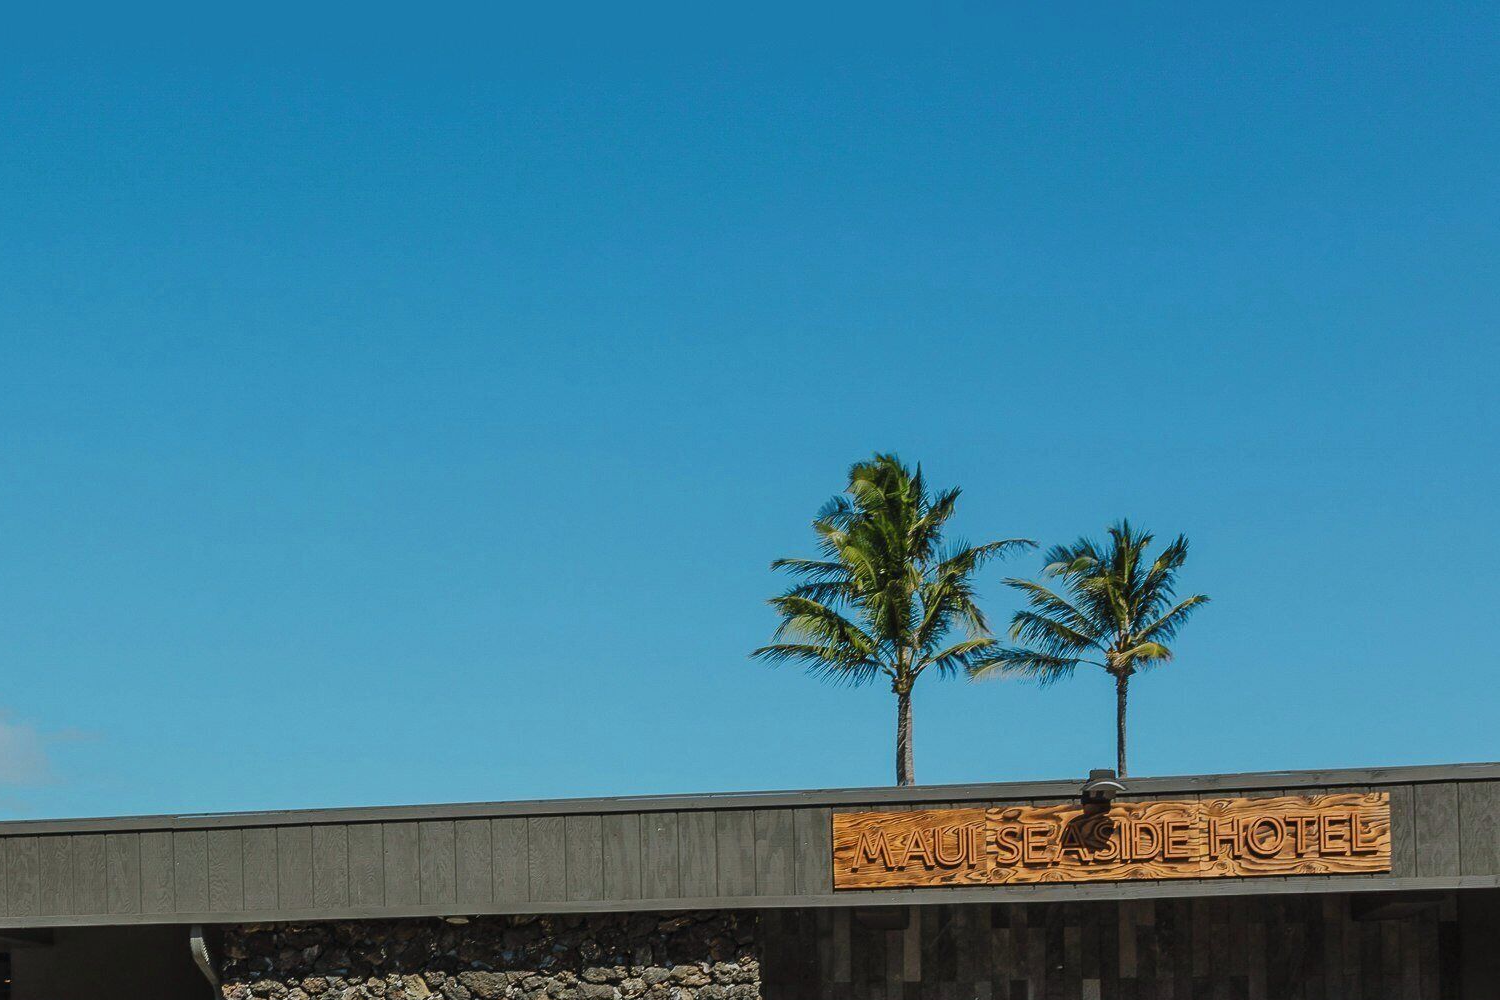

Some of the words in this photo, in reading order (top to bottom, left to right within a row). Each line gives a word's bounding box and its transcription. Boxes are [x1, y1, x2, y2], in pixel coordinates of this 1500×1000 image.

[851, 824, 978, 872] MAUI
[996, 818, 1192, 868] SEASIDE
[1207, 812, 1382, 861] HOTEL
